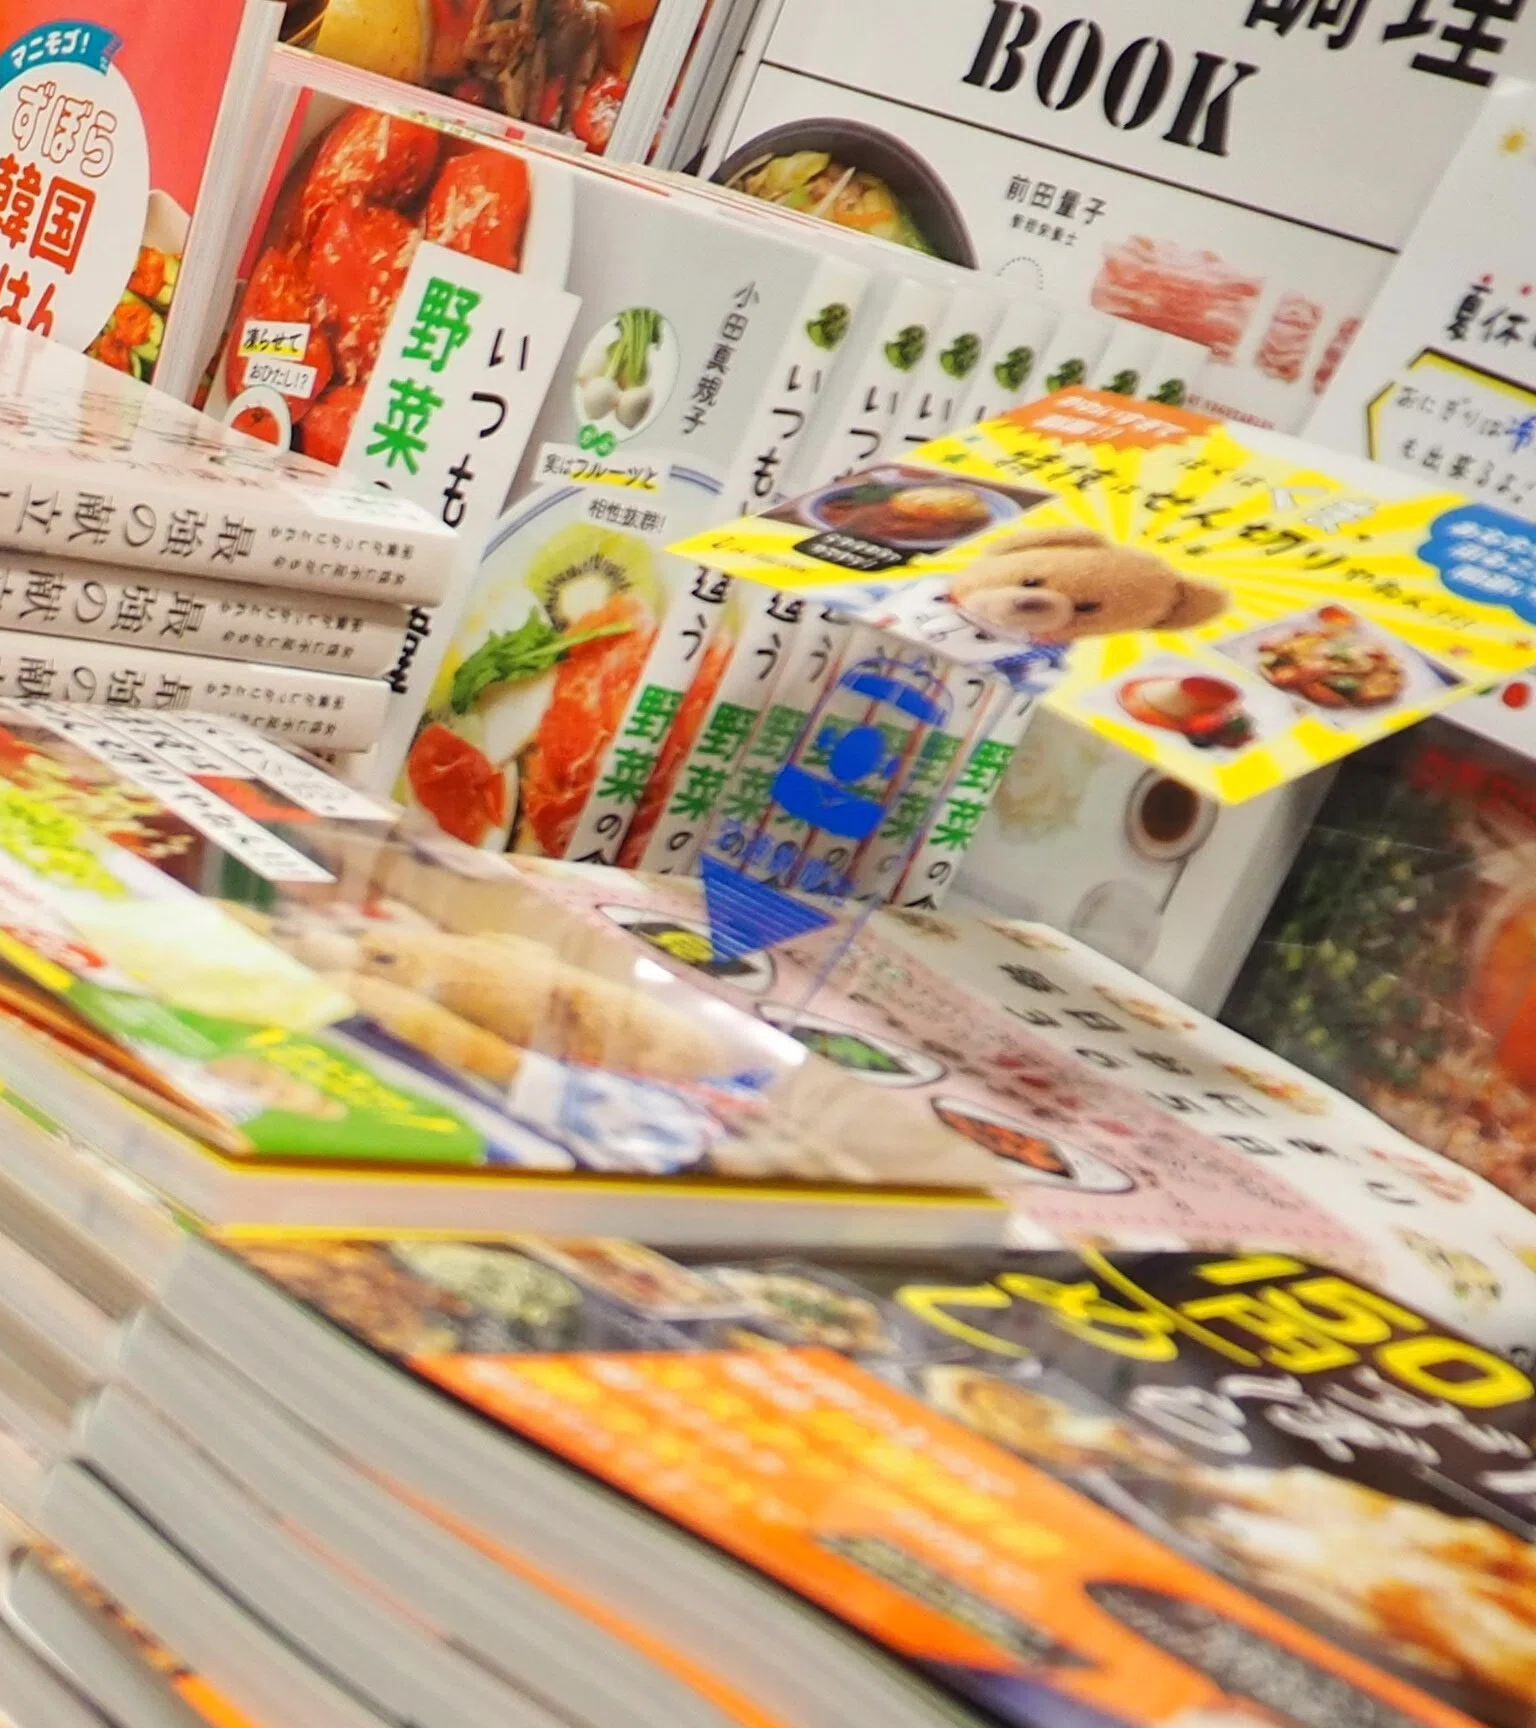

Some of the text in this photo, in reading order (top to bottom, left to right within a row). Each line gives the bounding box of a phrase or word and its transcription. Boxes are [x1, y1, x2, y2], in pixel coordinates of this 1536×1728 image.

[962, 0, 1260, 157] BOOK
[11, 81, 117, 178] ずぼら
[1005, 175, 1107, 224] 前田量子
[242, 327, 303, 353] 凍らせて
[1444, 281, 1536, 346] 夏休
[366, 276, 483, 489] 野菜
[681, 281, 760, 436] 小田真規子
[442, 326, 529, 528] いつも
[543, 453, 658, 490] 実はフルーツと
[589, 499, 666, 534] 相性抜群!
